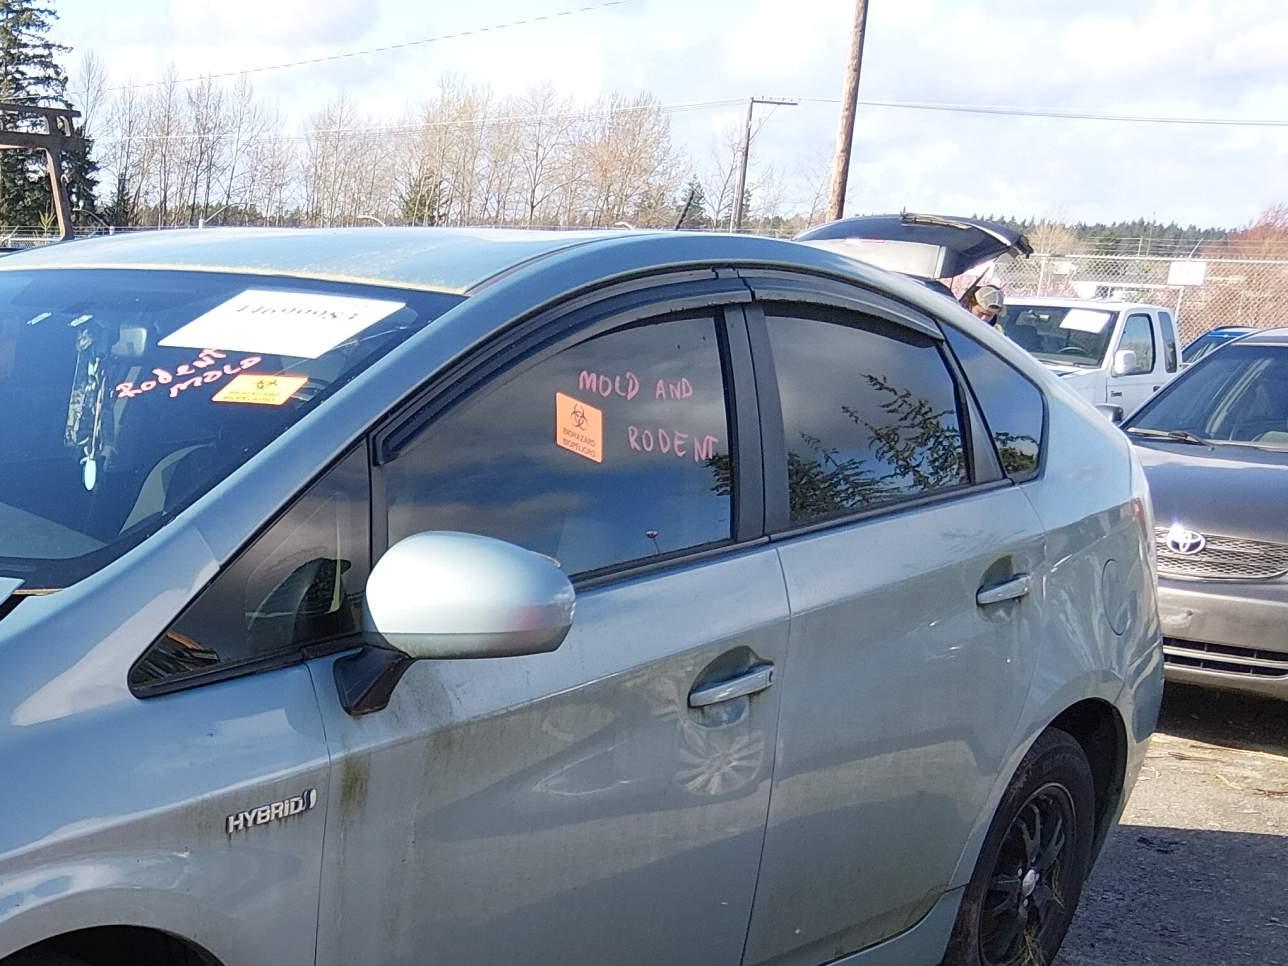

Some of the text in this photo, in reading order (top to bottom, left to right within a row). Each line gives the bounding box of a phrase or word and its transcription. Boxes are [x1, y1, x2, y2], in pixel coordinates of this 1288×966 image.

[578, 370, 694, 400] MOLD AND
[627, 425, 720, 462] RODENT
[227, 796, 306, 834] HYBRID
